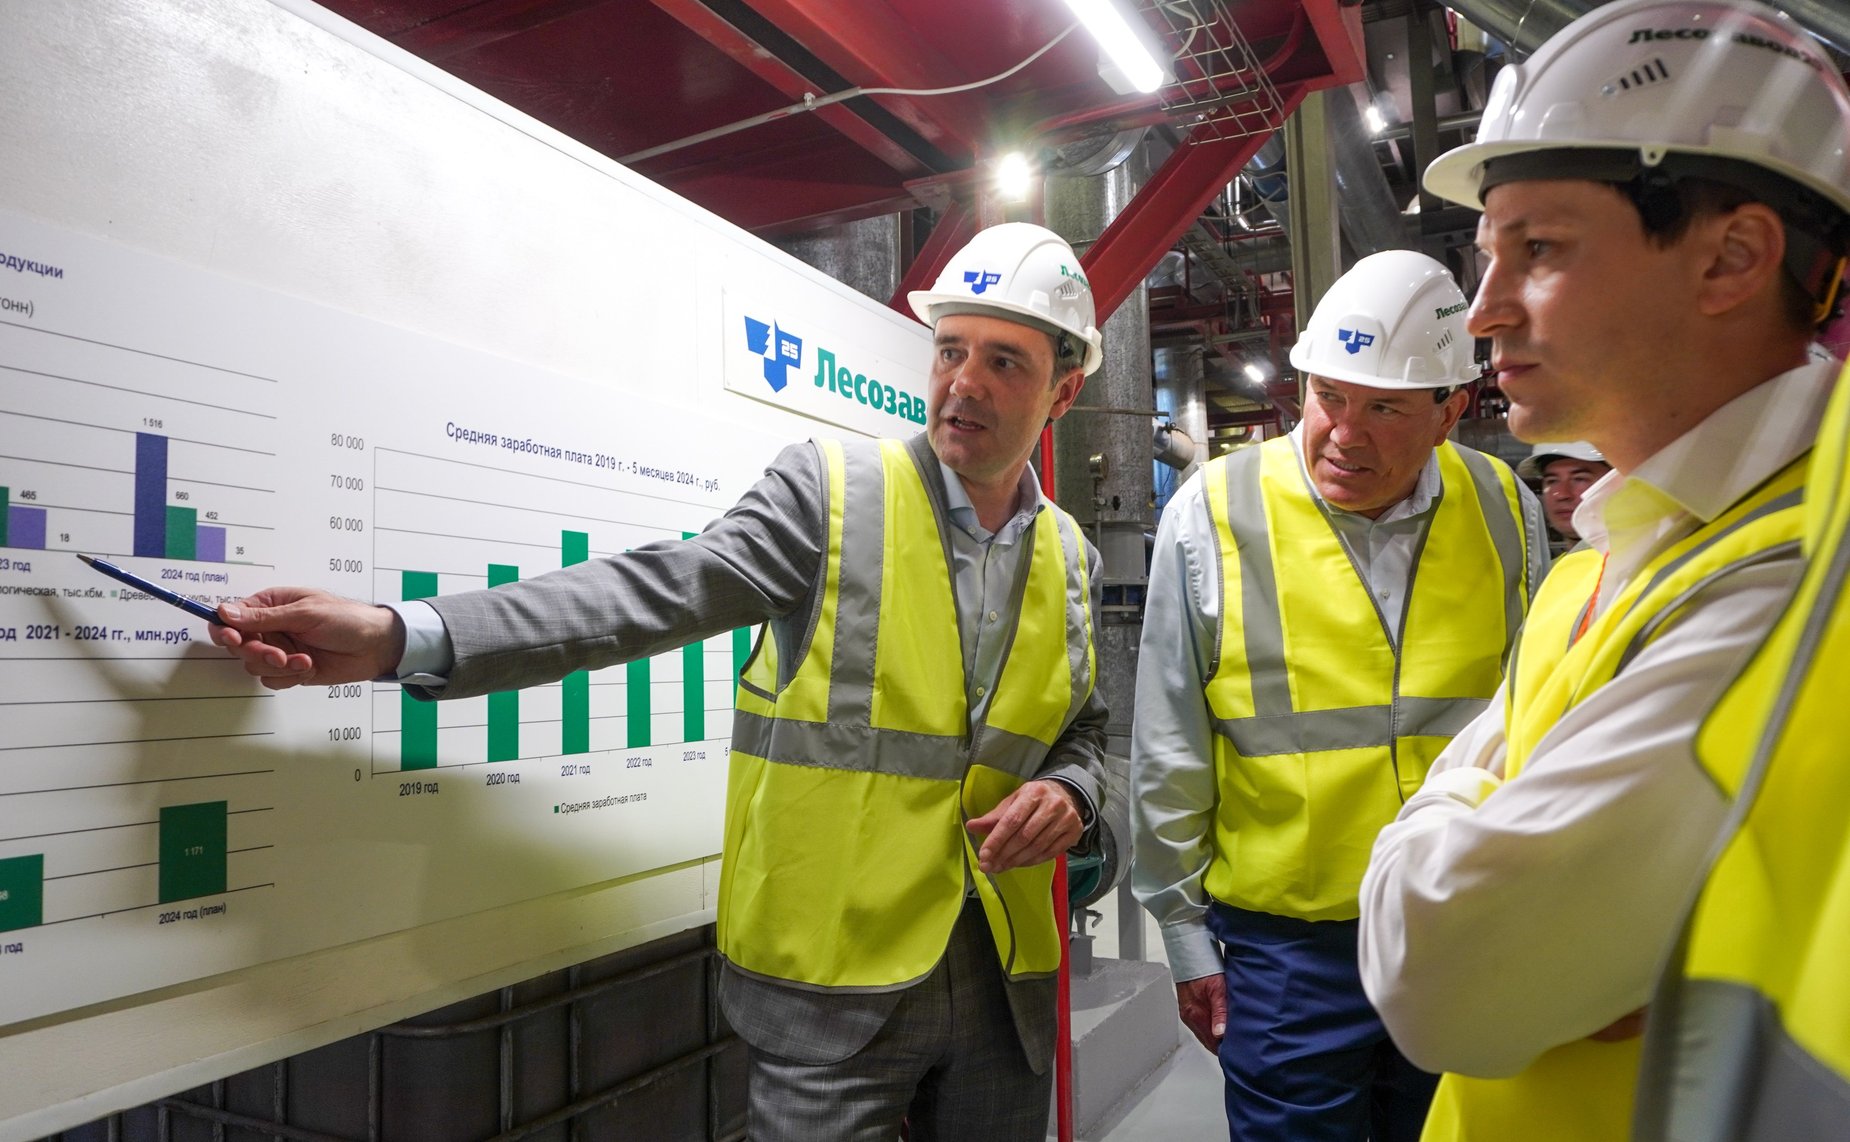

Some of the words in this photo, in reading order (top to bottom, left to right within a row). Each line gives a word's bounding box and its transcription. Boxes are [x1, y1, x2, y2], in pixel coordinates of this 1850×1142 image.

[0, 297, 34, 318] онн)
[781, 339, 799, 360] 25
[814, 346, 927, 426] Лесозав
[446, 421, 498, 446] Средняя
[500, 436, 562, 459] заработная
[564, 450, 593, 466] плата
[595, 453, 616, 470] 2019
[618, 460, 625, 472] г.
[632, 461, 638, 475] 5
[639, 465, 675, 482] месяцев
[676, 470, 694, 486] 2024
[705, 478, 721, 492] руб.
[60, 533, 70, 543] 18
[12, 561, 31, 573] год
[161, 568, 183, 580] 2024
[185, 572, 200, 583] год
[202, 571, 229, 585] (план)
[26, 625, 60, 640] 2021
[74, 626, 107, 640] 2024
[111, 630, 131, 643] гг.,
[135, 628, 192, 644] млн.руб.
[626, 757, 641, 769] 2022
[642, 758, 652, 768] год
[683, 751, 696, 761] 2023
[697, 752, 706, 760] год
[354, 768, 361, 782] 0
[561, 765, 578, 777] 2021
[579, 764, 591, 776] год
[486, 772, 505, 786] 2020
[507, 772, 520, 785] год
[399, 782, 422, 796] 2019
[424, 782, 439, 795] год
[560, 801, 591, 816] Средняя
[592, 795, 629, 810] заработная
[629, 792, 648, 803] плата
[159, 911, 181, 924] 2024
[182, 909, 198, 920] год
[200, 902, 227, 918] (план)
[4, 942, 23, 954] год
